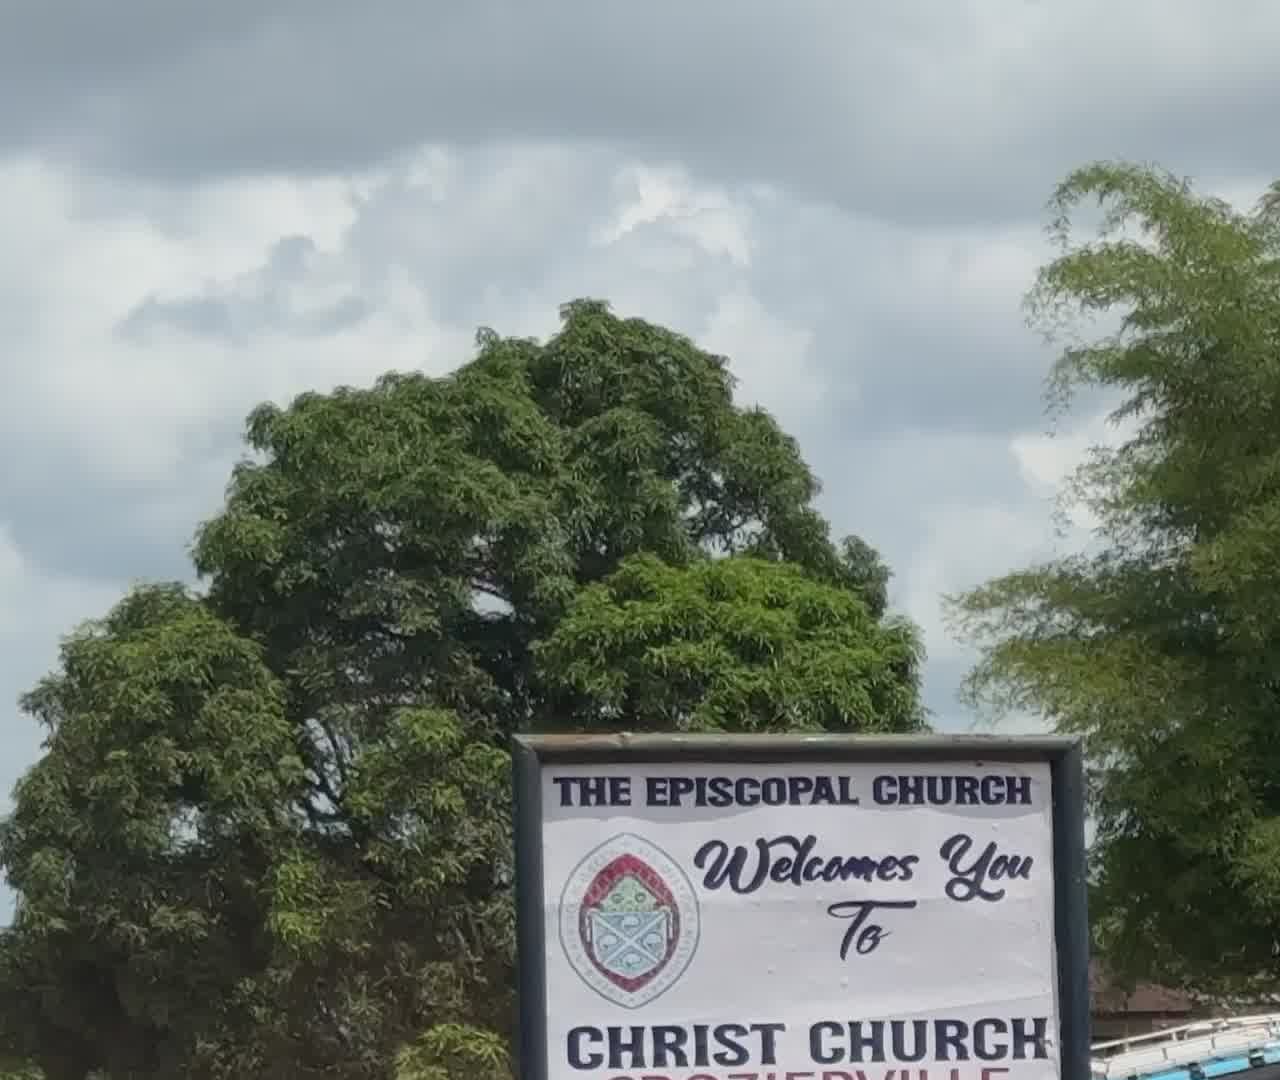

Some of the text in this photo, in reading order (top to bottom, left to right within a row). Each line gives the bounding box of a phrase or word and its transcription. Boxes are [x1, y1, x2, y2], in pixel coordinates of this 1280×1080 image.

[553, 775, 1034, 808] THE EPISCOPAL CHURCH
[694, 833, 1034, 901] Welcomes You
[827, 900, 918, 961] To
[567, 1017, 1049, 1070] CHRIST CHURCH
